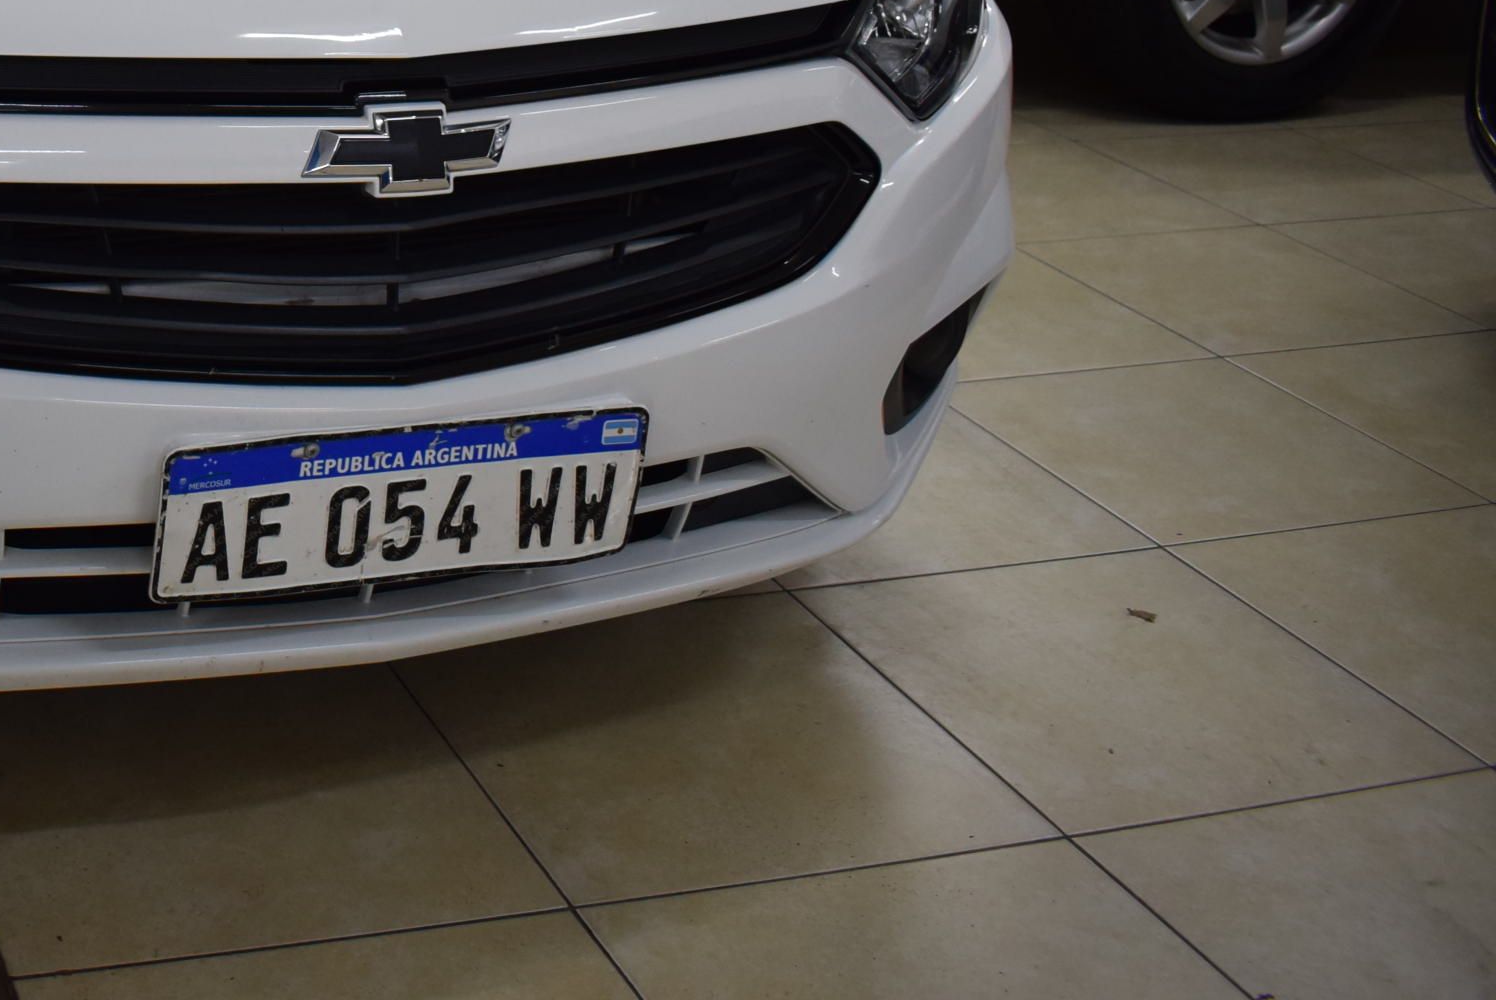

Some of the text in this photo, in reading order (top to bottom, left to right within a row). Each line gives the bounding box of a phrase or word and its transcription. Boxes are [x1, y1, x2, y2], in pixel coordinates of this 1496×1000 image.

[299, 441, 518, 478] REPUBLICA ARGENTINA
[188, 479, 232, 491] MERCOSUR
[180, 462, 617, 584] AE 054 WW
